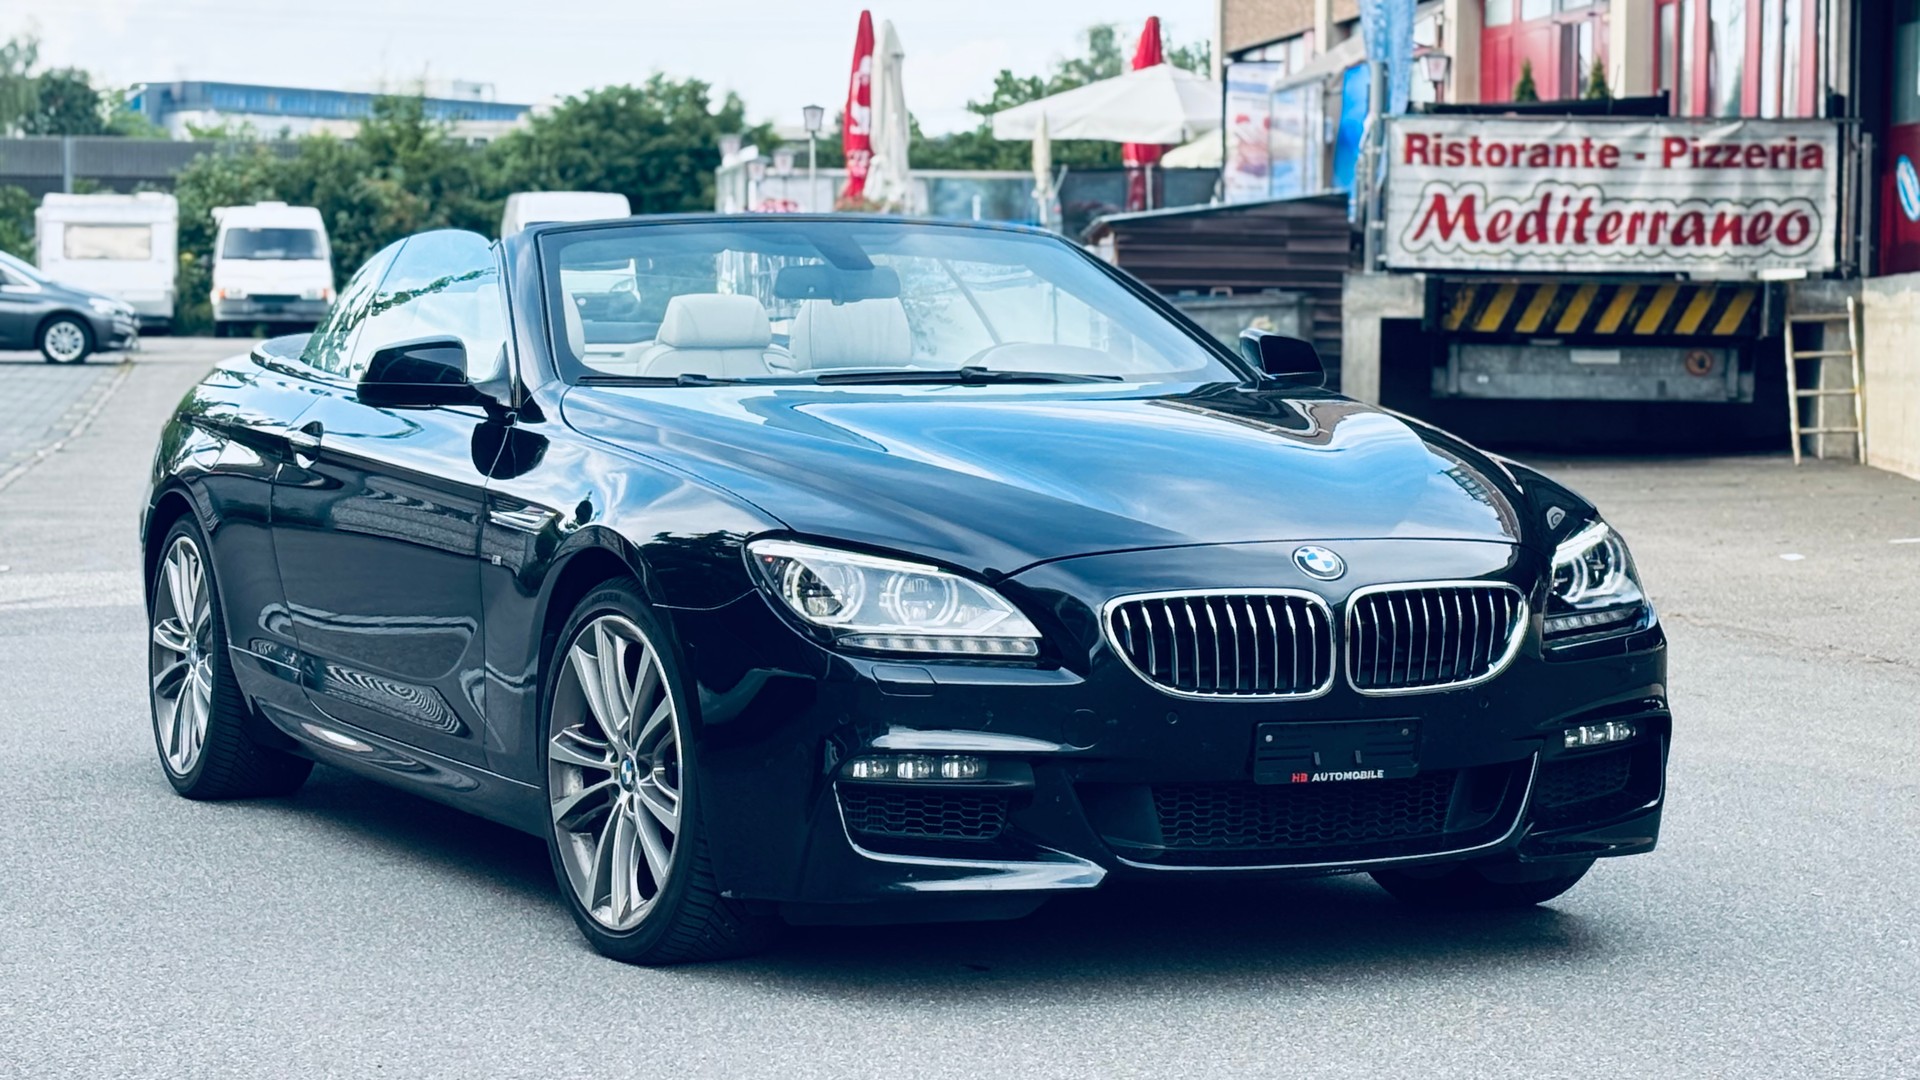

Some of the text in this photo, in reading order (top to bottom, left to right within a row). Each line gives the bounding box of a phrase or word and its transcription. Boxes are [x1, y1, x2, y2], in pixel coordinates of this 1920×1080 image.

[1404, 133, 1620, 168] Ristorante
[1662, 136, 1824, 169] Pizzeria
[1412, 192, 1811, 247] Mediterraneo
[1291, 770, 1385, 783] HB AUTOMOBILE
